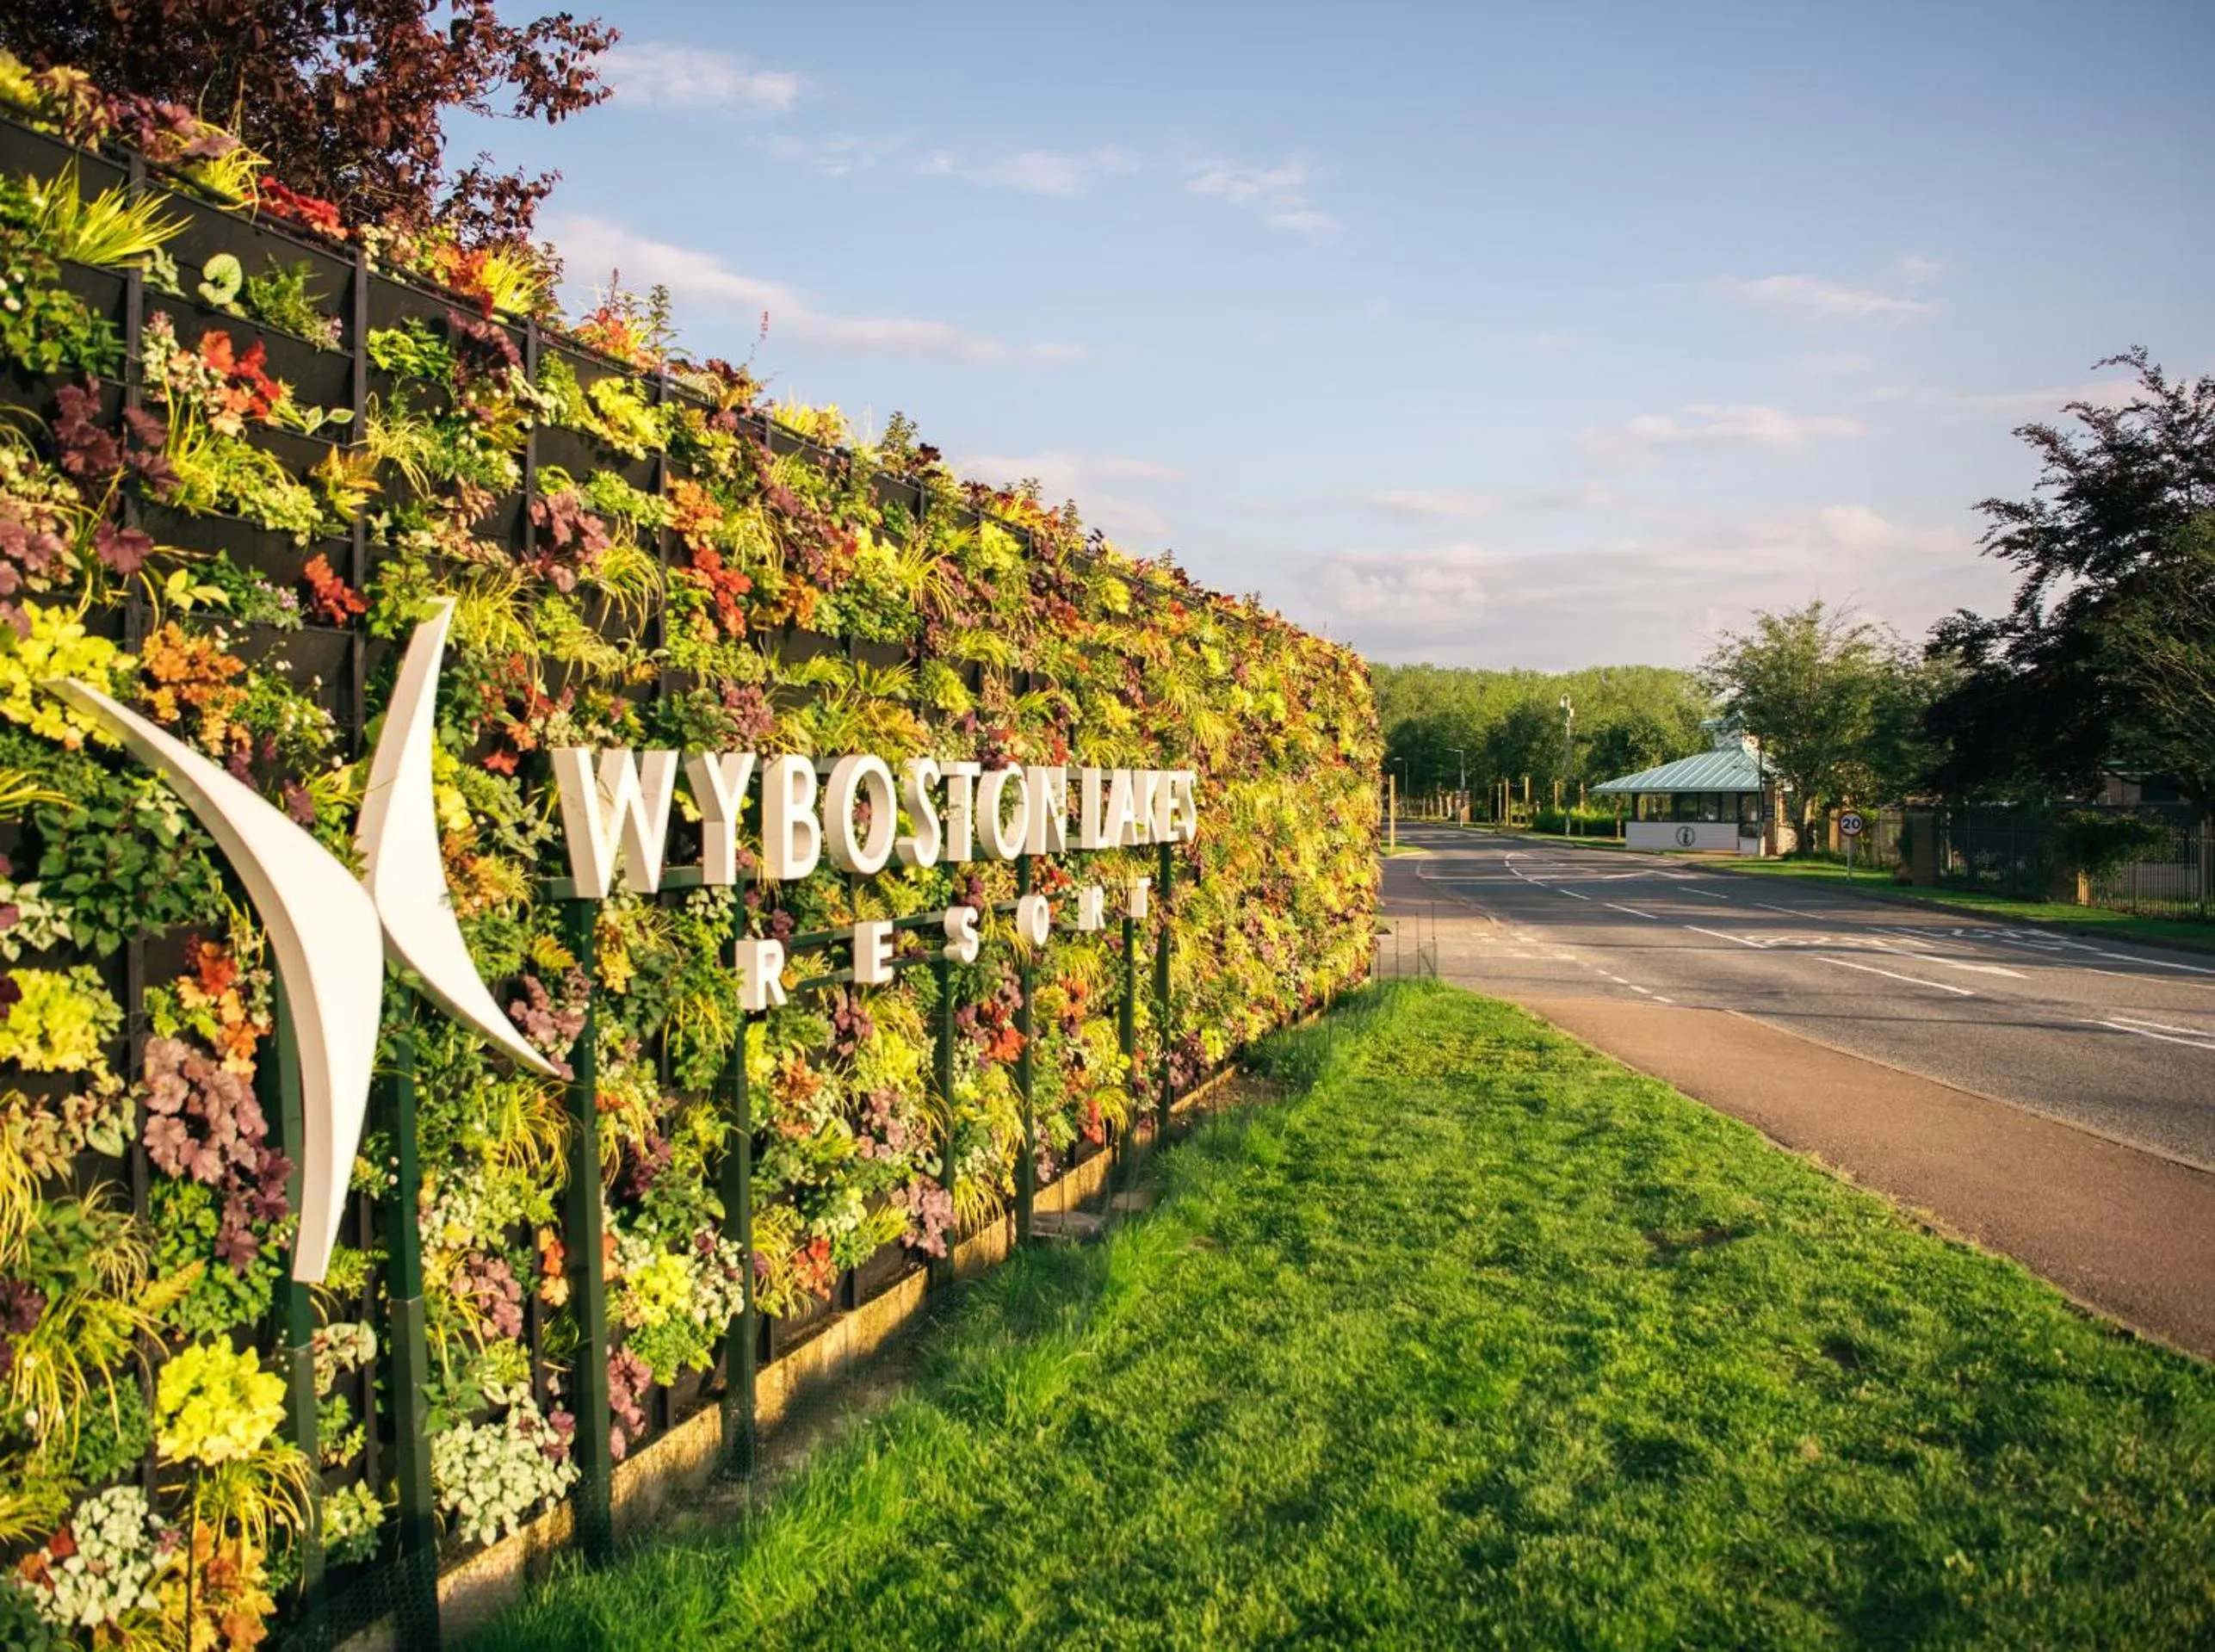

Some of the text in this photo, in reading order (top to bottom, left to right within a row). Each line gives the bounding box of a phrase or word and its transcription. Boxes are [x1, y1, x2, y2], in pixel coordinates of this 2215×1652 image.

[551, 747, 1197, 898] WYBOSTON LAKES
[1842, 818, 1861, 830] 20
[735, 876, 1151, 1010] RESORT
